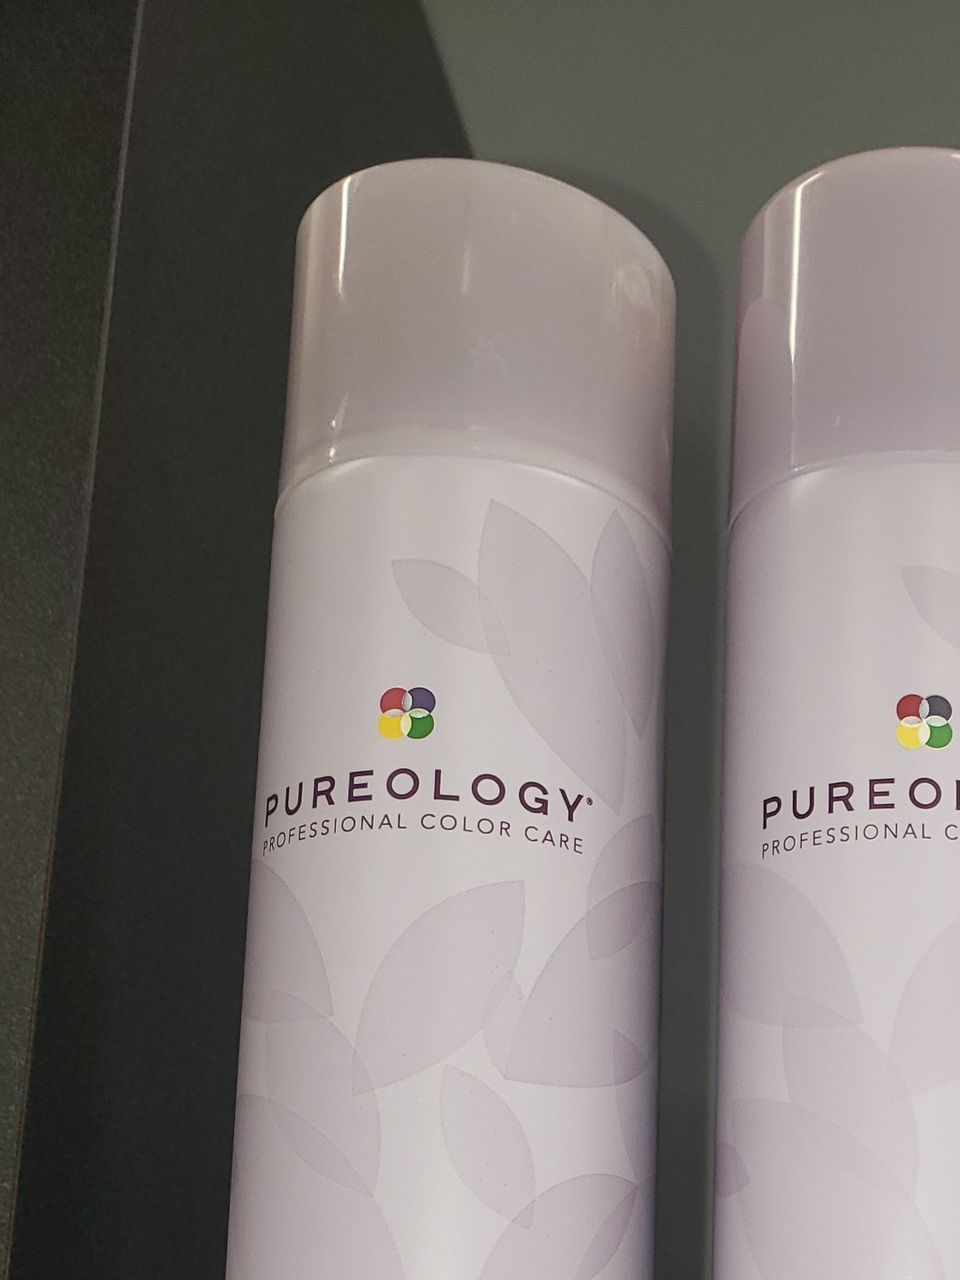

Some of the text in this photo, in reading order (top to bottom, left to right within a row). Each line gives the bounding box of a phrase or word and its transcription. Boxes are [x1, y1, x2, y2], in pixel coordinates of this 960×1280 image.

[263, 813, 583, 856] PROFESSIONAL COLOR CARE
[761, 823, 931, 859] PROFESSIONAL
